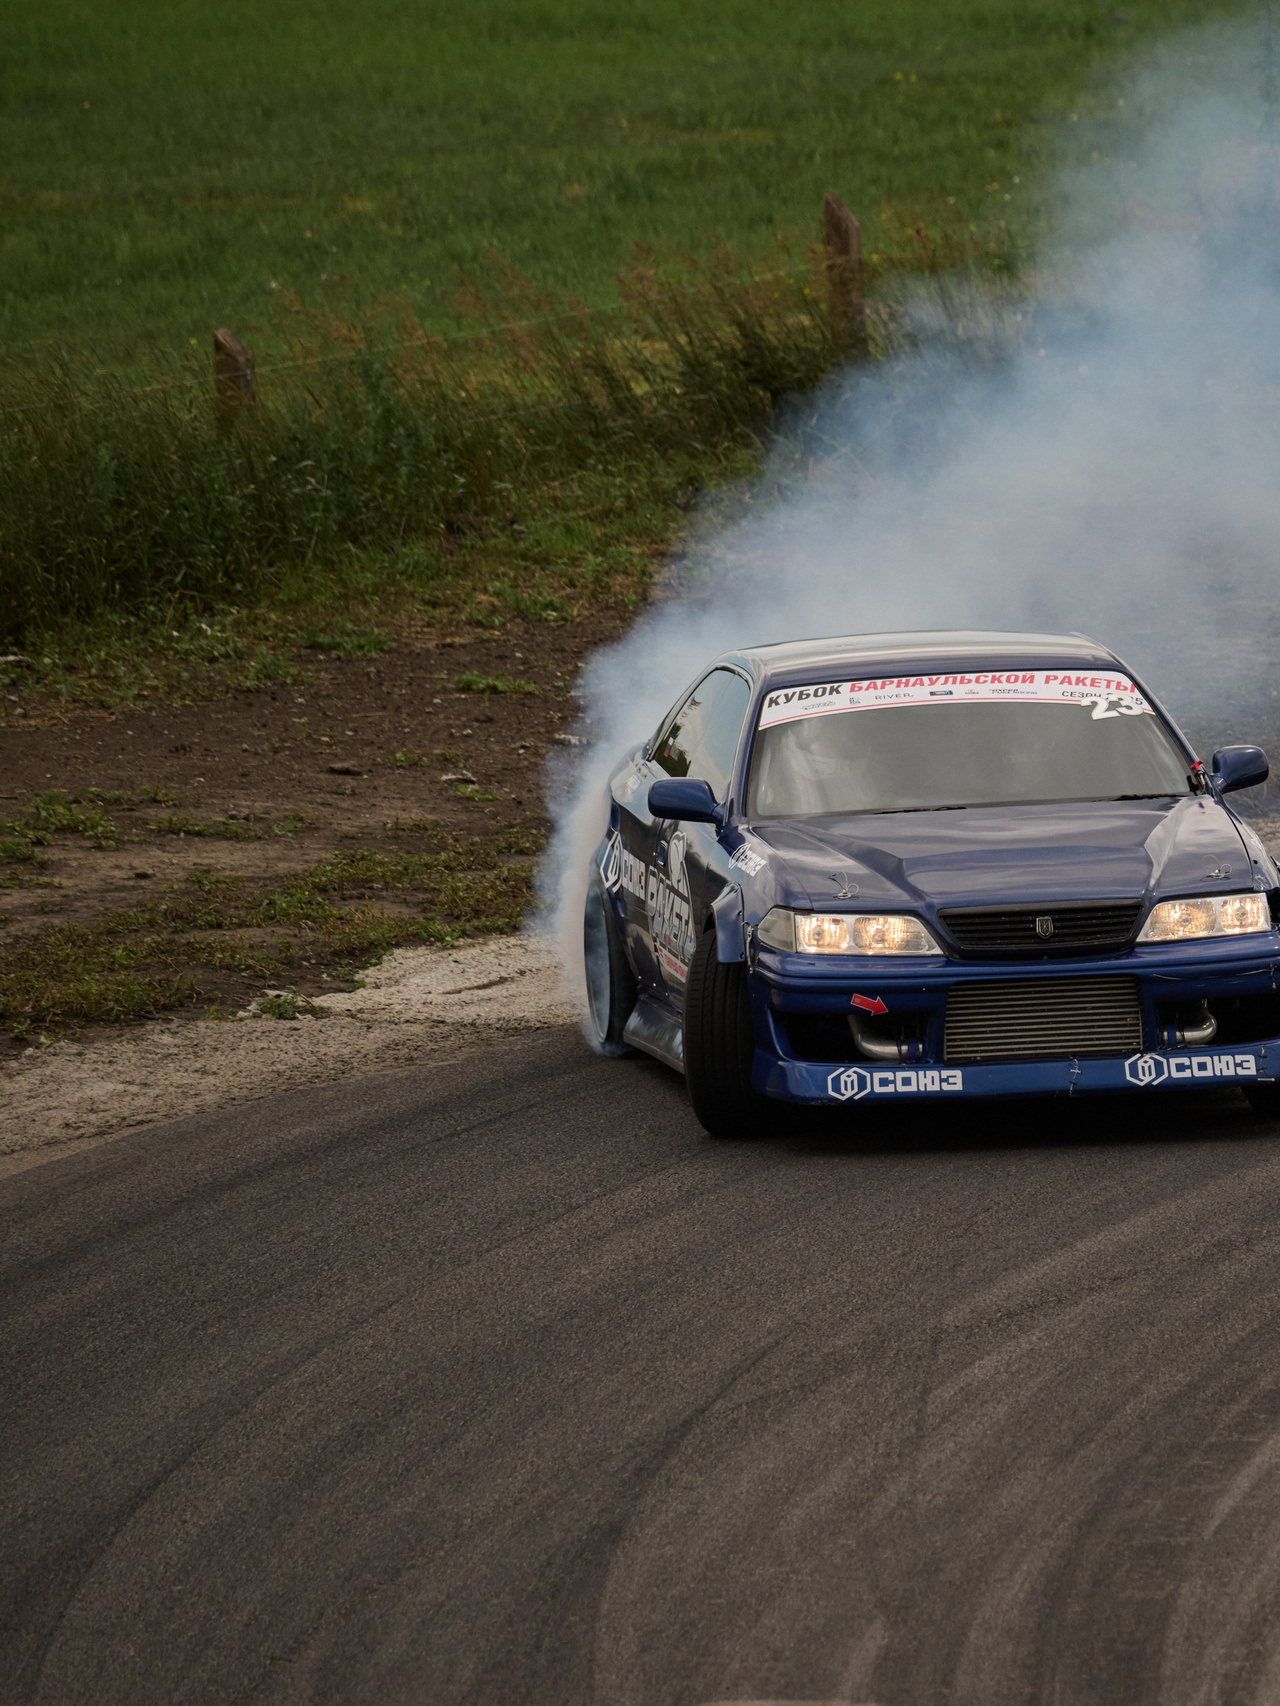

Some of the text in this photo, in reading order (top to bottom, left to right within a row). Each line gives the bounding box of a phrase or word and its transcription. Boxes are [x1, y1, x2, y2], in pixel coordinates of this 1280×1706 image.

[767, 684, 843, 708] КУБОК
[849, 673, 1036, 693] БАРНАУЛЬСКОЙ
[1044, 674, 1136, 693] РАКЕТЫ
[1080, 694, 1144, 719] 23
[1169, 1054, 1257, 1079] СОЮЗ
[873, 1070, 963, 1093] СОЮЗ
